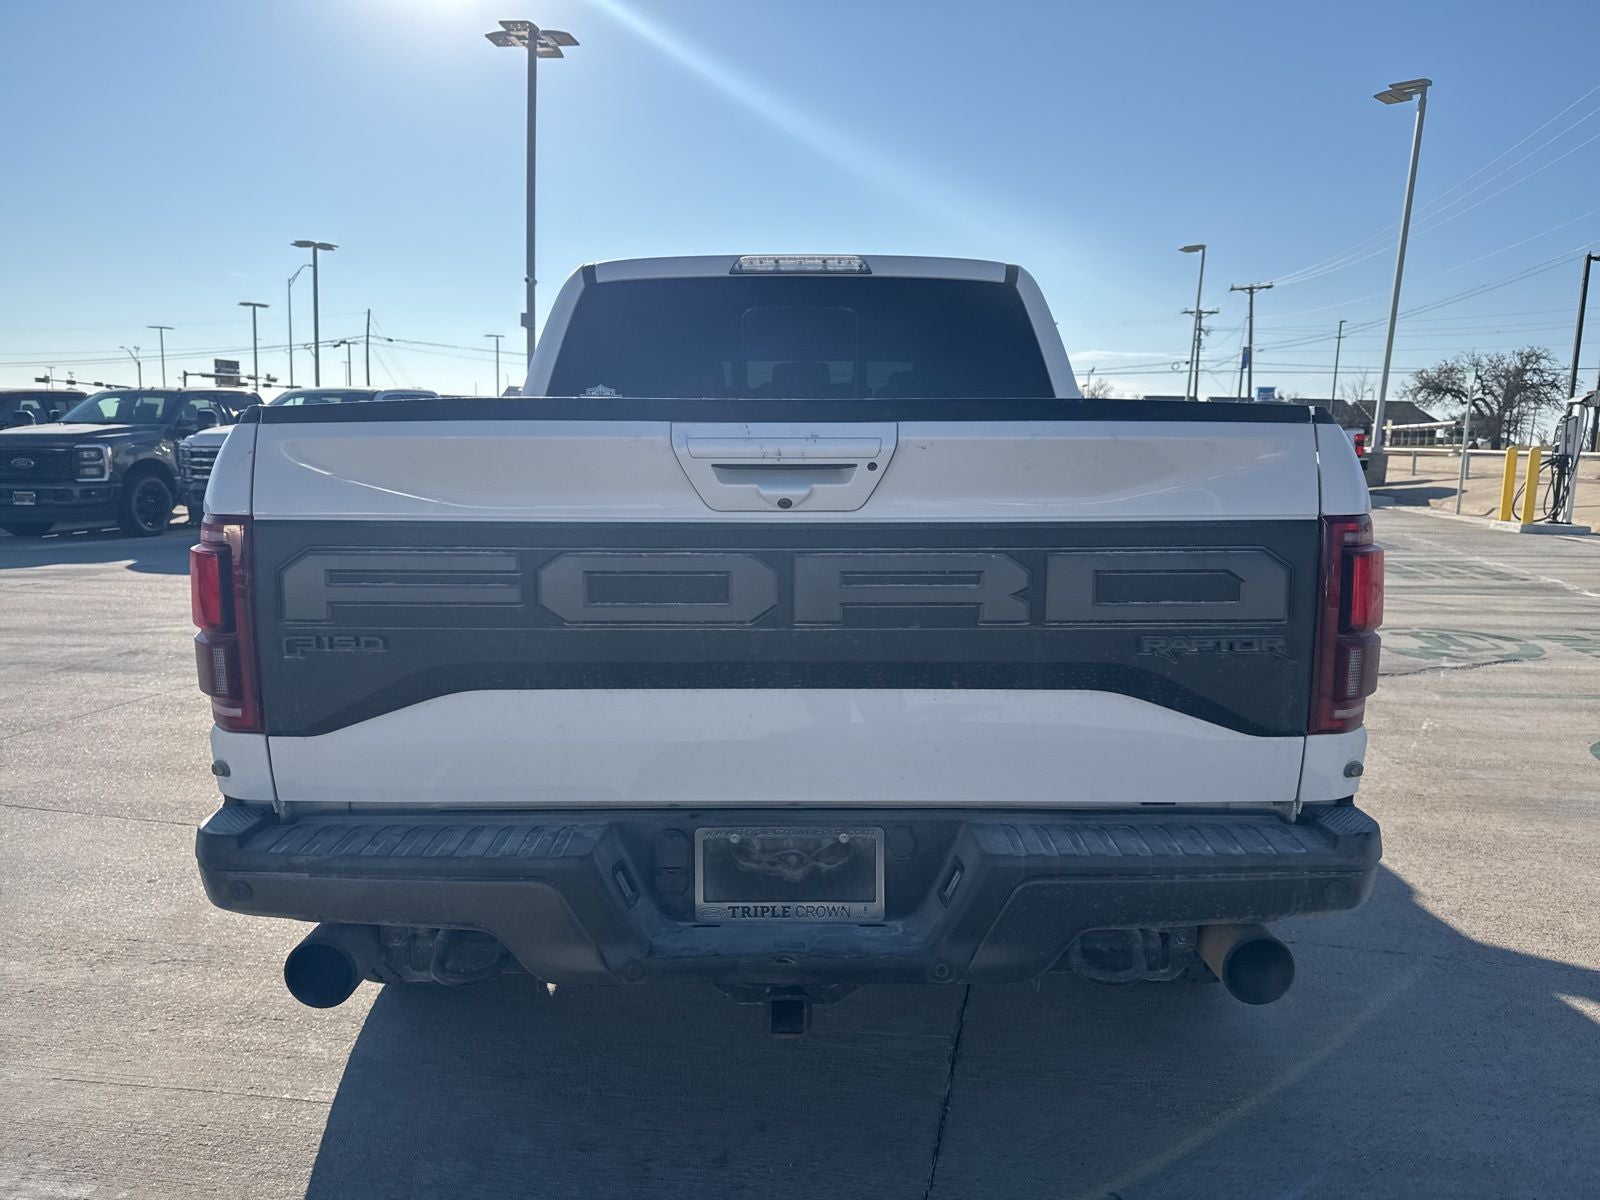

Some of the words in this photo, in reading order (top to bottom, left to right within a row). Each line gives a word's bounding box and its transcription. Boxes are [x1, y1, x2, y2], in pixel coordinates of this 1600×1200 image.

[280, 549, 1292, 625] FORD
[1137, 635, 1296, 663] RAPTOR
[727, 905, 791, 919] TRIPLE
[796, 905, 851, 919] CROWN
